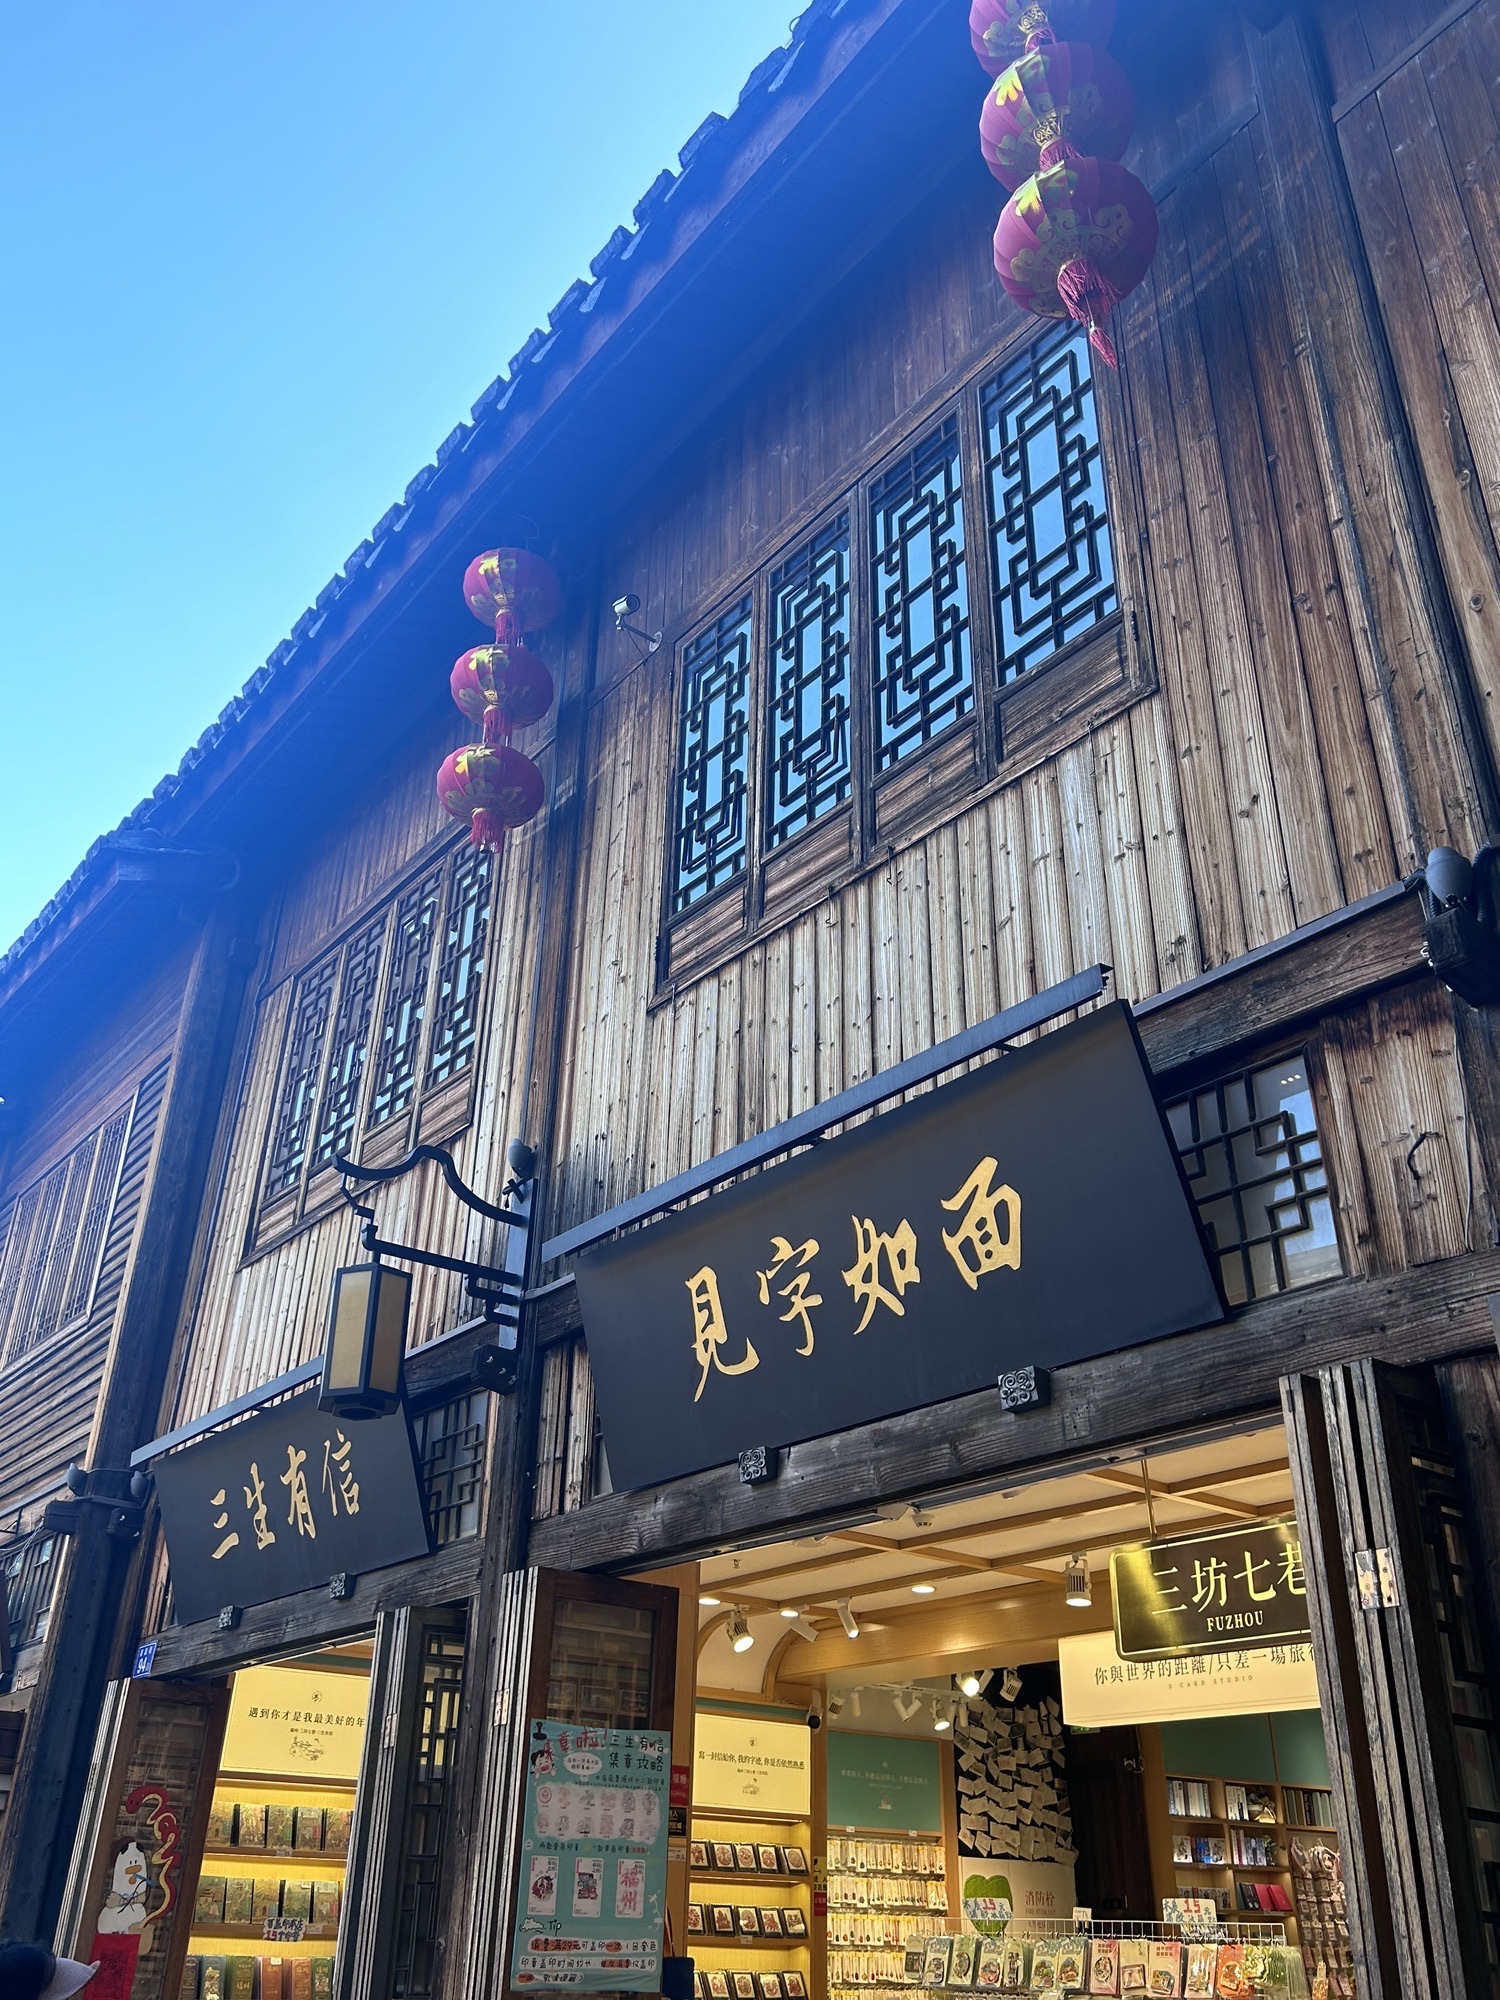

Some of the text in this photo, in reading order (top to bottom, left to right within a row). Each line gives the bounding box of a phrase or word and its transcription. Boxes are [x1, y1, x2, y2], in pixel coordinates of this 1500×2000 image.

[684, 1155, 1022, 1403] 見字如面
[210, 1427, 360, 1560] 三生有信
[1152, 1541, 1307, 1615] 三坊七巷
[1206, 1610, 1264, 1632] FUZHOU
[1213, 1674, 1253, 1685] STUDIO
[247, 1706, 366, 1728] 遇到你才是我最美好的年
[609, 1733, 665, 1753] 三生有信
[609, 1751, 664, 1772] 集章攻略
[982, 1898, 997, 1911] 15
[1025, 1890, 1056, 1907] 消防栓
[1183, 1898, 1201, 1914] 15
[548, 1919, 562, 1936] Tip
